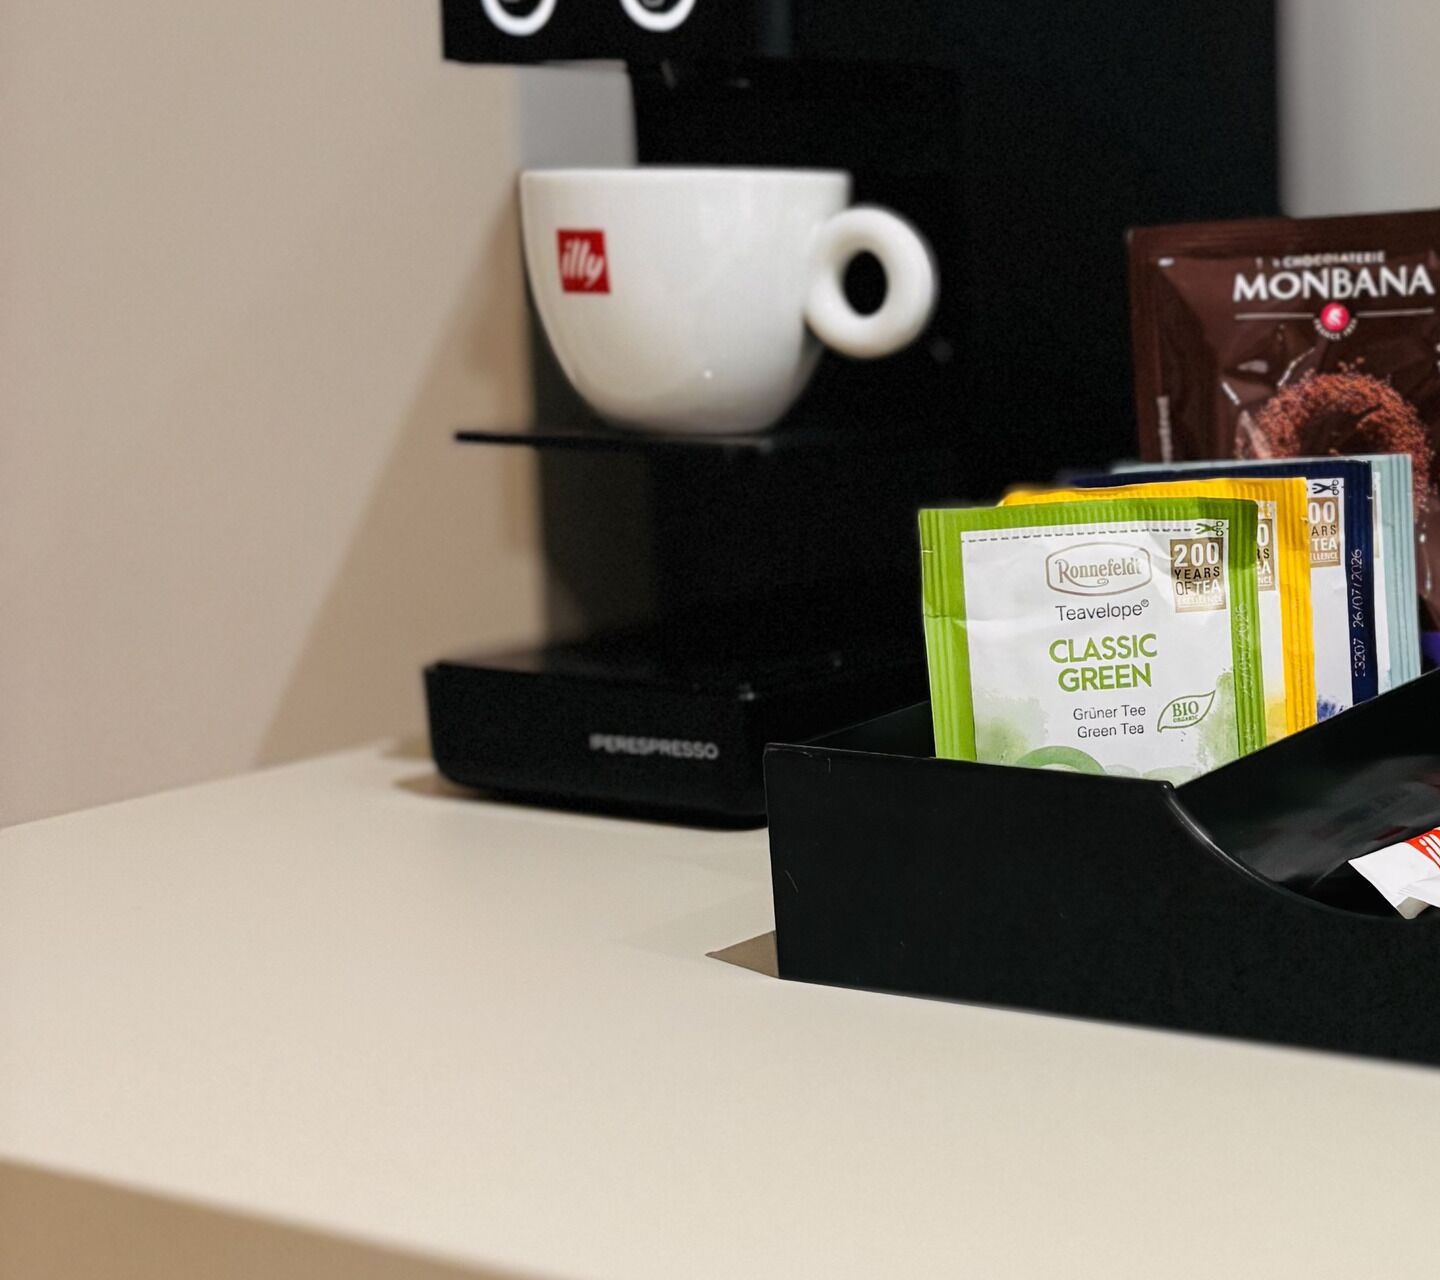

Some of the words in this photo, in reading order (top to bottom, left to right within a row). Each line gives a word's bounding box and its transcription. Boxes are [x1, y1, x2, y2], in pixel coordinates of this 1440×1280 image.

[562, 237, 605, 289] illy
[1233, 263, 1436, 302] MONBANA
[1308, 501, 1336, 524] 00
[1311, 524, 1337, 536] ARS
[1173, 542, 1220, 568] 200
[1055, 557, 1143, 589] Ronnefeldt
[1174, 566, 1221, 580] YEARS
[1175, 581, 1192, 596] OF
[1192, 579, 1221, 596] TEA
[1049, 633, 1158, 664] CLASSIC
[1058, 663, 1152, 692] GREEN
[1073, 706, 1118, 721] Grüner
[1121, 704, 1146, 717] Tee
[1172, 701, 1199, 717] BIO
[1077, 724, 1117, 739] Green
[1120, 722, 1145, 735] Tea
